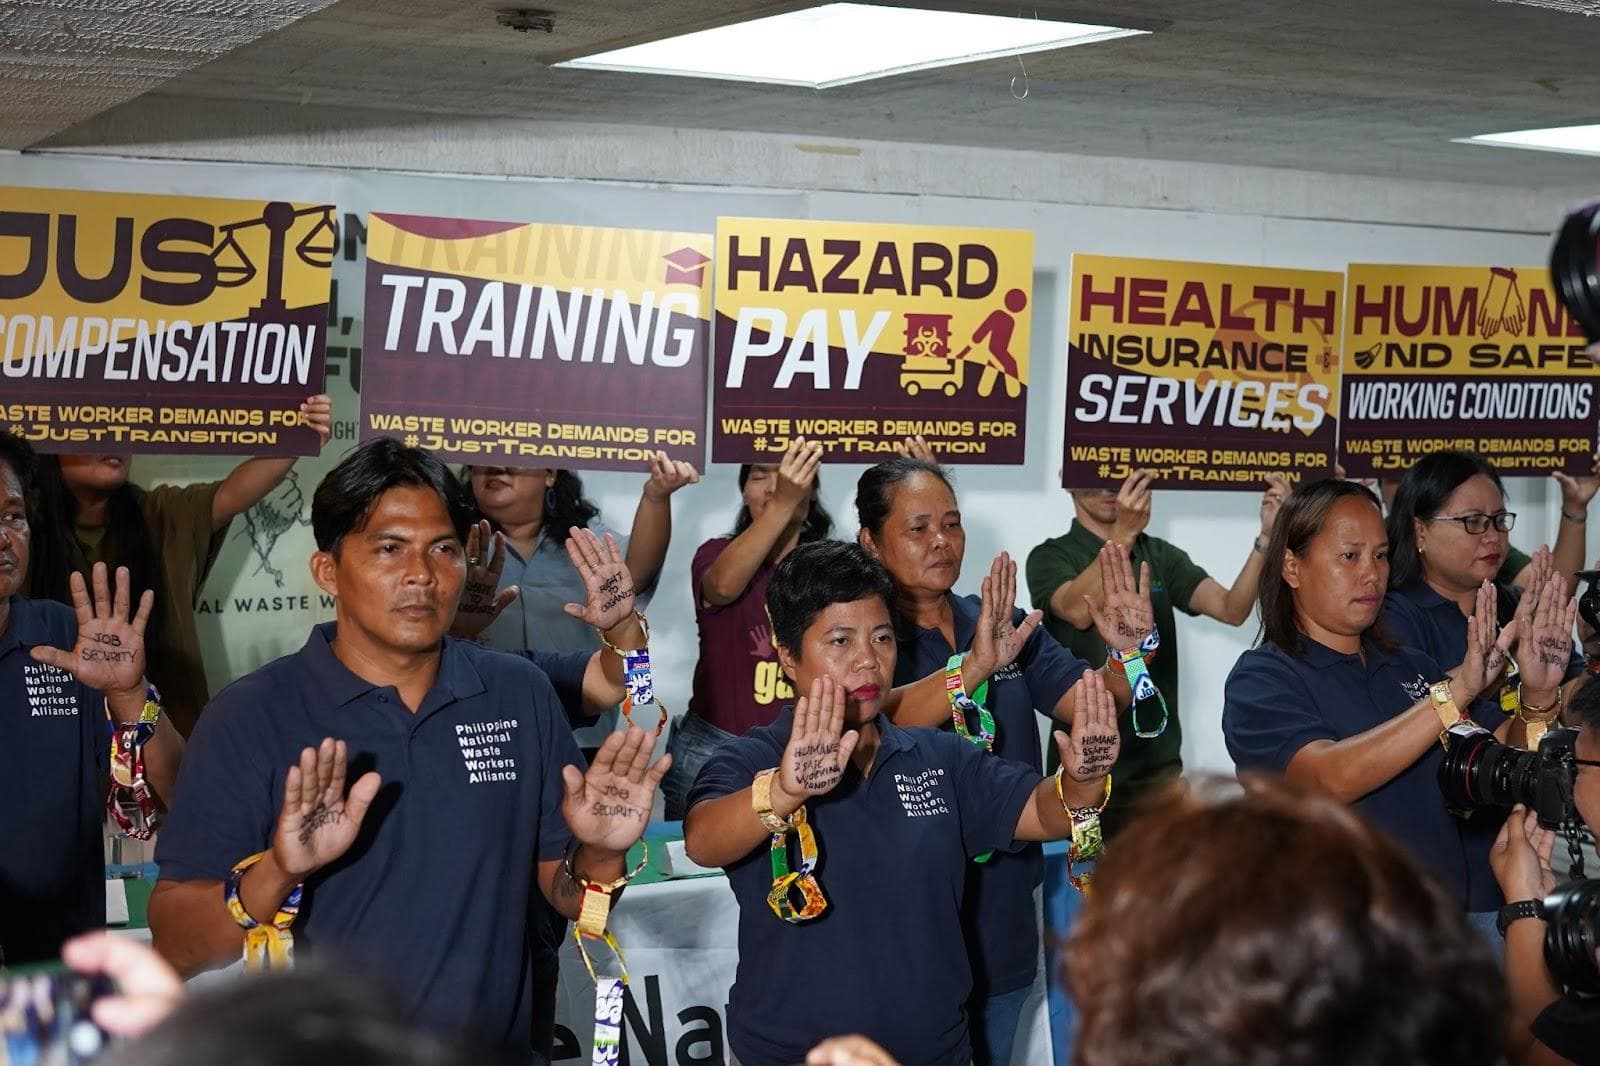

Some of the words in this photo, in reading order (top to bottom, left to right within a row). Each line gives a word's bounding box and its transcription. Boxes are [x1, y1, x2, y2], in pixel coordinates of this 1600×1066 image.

[728, 235, 998, 299] HAZARD
[1080, 274, 1336, 335] HEALTH
[381, 274, 699, 367] TRAINING
[0, 314, 316, 385] OMPENSATION
[725, 307, 892, 389] PAY
[1078, 333, 1308, 373] INSURANCE
[1469, 344, 1594, 368] SAFE
[1075, 374, 1328, 429] SERVICES
[1349, 382, 1456, 420] WORKING
[1459, 382, 1593, 420] CONDITIONS
[58, 406, 153, 424] WORKER
[160, 408, 264, 426] DEMANDS
[269, 410, 310, 427] FOR
[370, 414, 444, 433] WASTE
[450, 418, 541, 438] WORKER
[547, 424, 648, 443] DEMANDS
[654, 429, 696, 445] FOR
[722, 419, 790, 434] WASTE
[795, 420, 878, 435] WORKER
[883, 420, 974, 436] DEMANDS
[978, 421, 1016, 437] FOR
[1346, 440, 1401, 454] WASTE
[1407, 439, 1475, 453] WORKER
[1479, 438, 1554, 453] DEMANDS
[1559, 438, 1590, 452] FOR
[1071, 446, 1131, 462] WASTE
[1136, 449, 1208, 464] WORKER
[1212, 451, 1291, 467] DEMANDS
[1295, 453, 1327, 468] FOR
[235, 596, 309, 612] WASTE
[601, 589, 634, 612] ORGANIZ
[94, 633, 121, 647] JOB
[82, 648, 137, 663] SECURITY
[25, 673, 73, 685] National
[754, 661, 794, 704] ga
[27, 685, 62, 696] Waste
[29, 696, 77, 706] Workers
[32, 707, 78, 717] Alliance
[455, 720, 518, 735] Philippine
[458, 731, 511, 747] National
[461, 746, 501, 759] Waste
[465, 758, 515, 771] Workers
[469, 770, 517, 784] Alliance
[894, 768, 944, 784] Philippine
[603, 785, 629, 799] JOB
[897, 778, 938, 792] National
[899, 791, 931, 802] Waste
[592, 802, 643, 822] SECURITY
[620, 975, 729, 1066] Na
